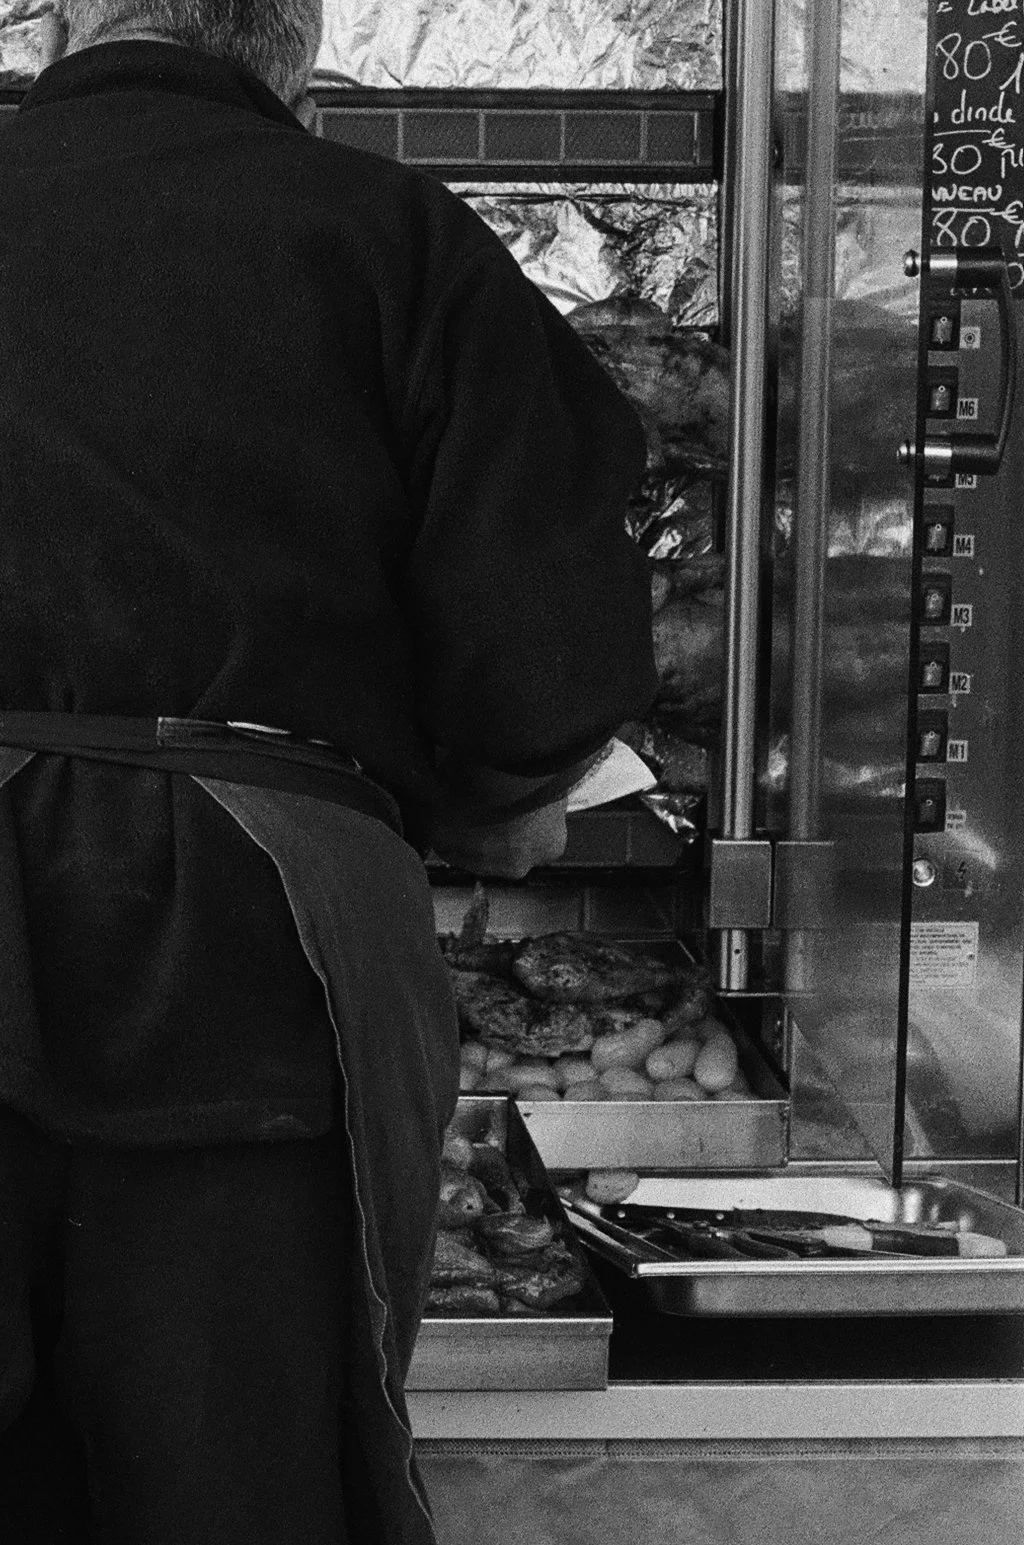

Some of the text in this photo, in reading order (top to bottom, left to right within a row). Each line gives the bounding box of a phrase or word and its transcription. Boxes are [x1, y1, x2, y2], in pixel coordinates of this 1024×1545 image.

[951, 89, 1016, 125] dinde
[959, 400, 975, 417] M6
[956, 536, 973, 554] M4
[953, 607, 970, 624] M3
[952, 675, 968, 691] M2
[949, 743, 966, 759] M1
